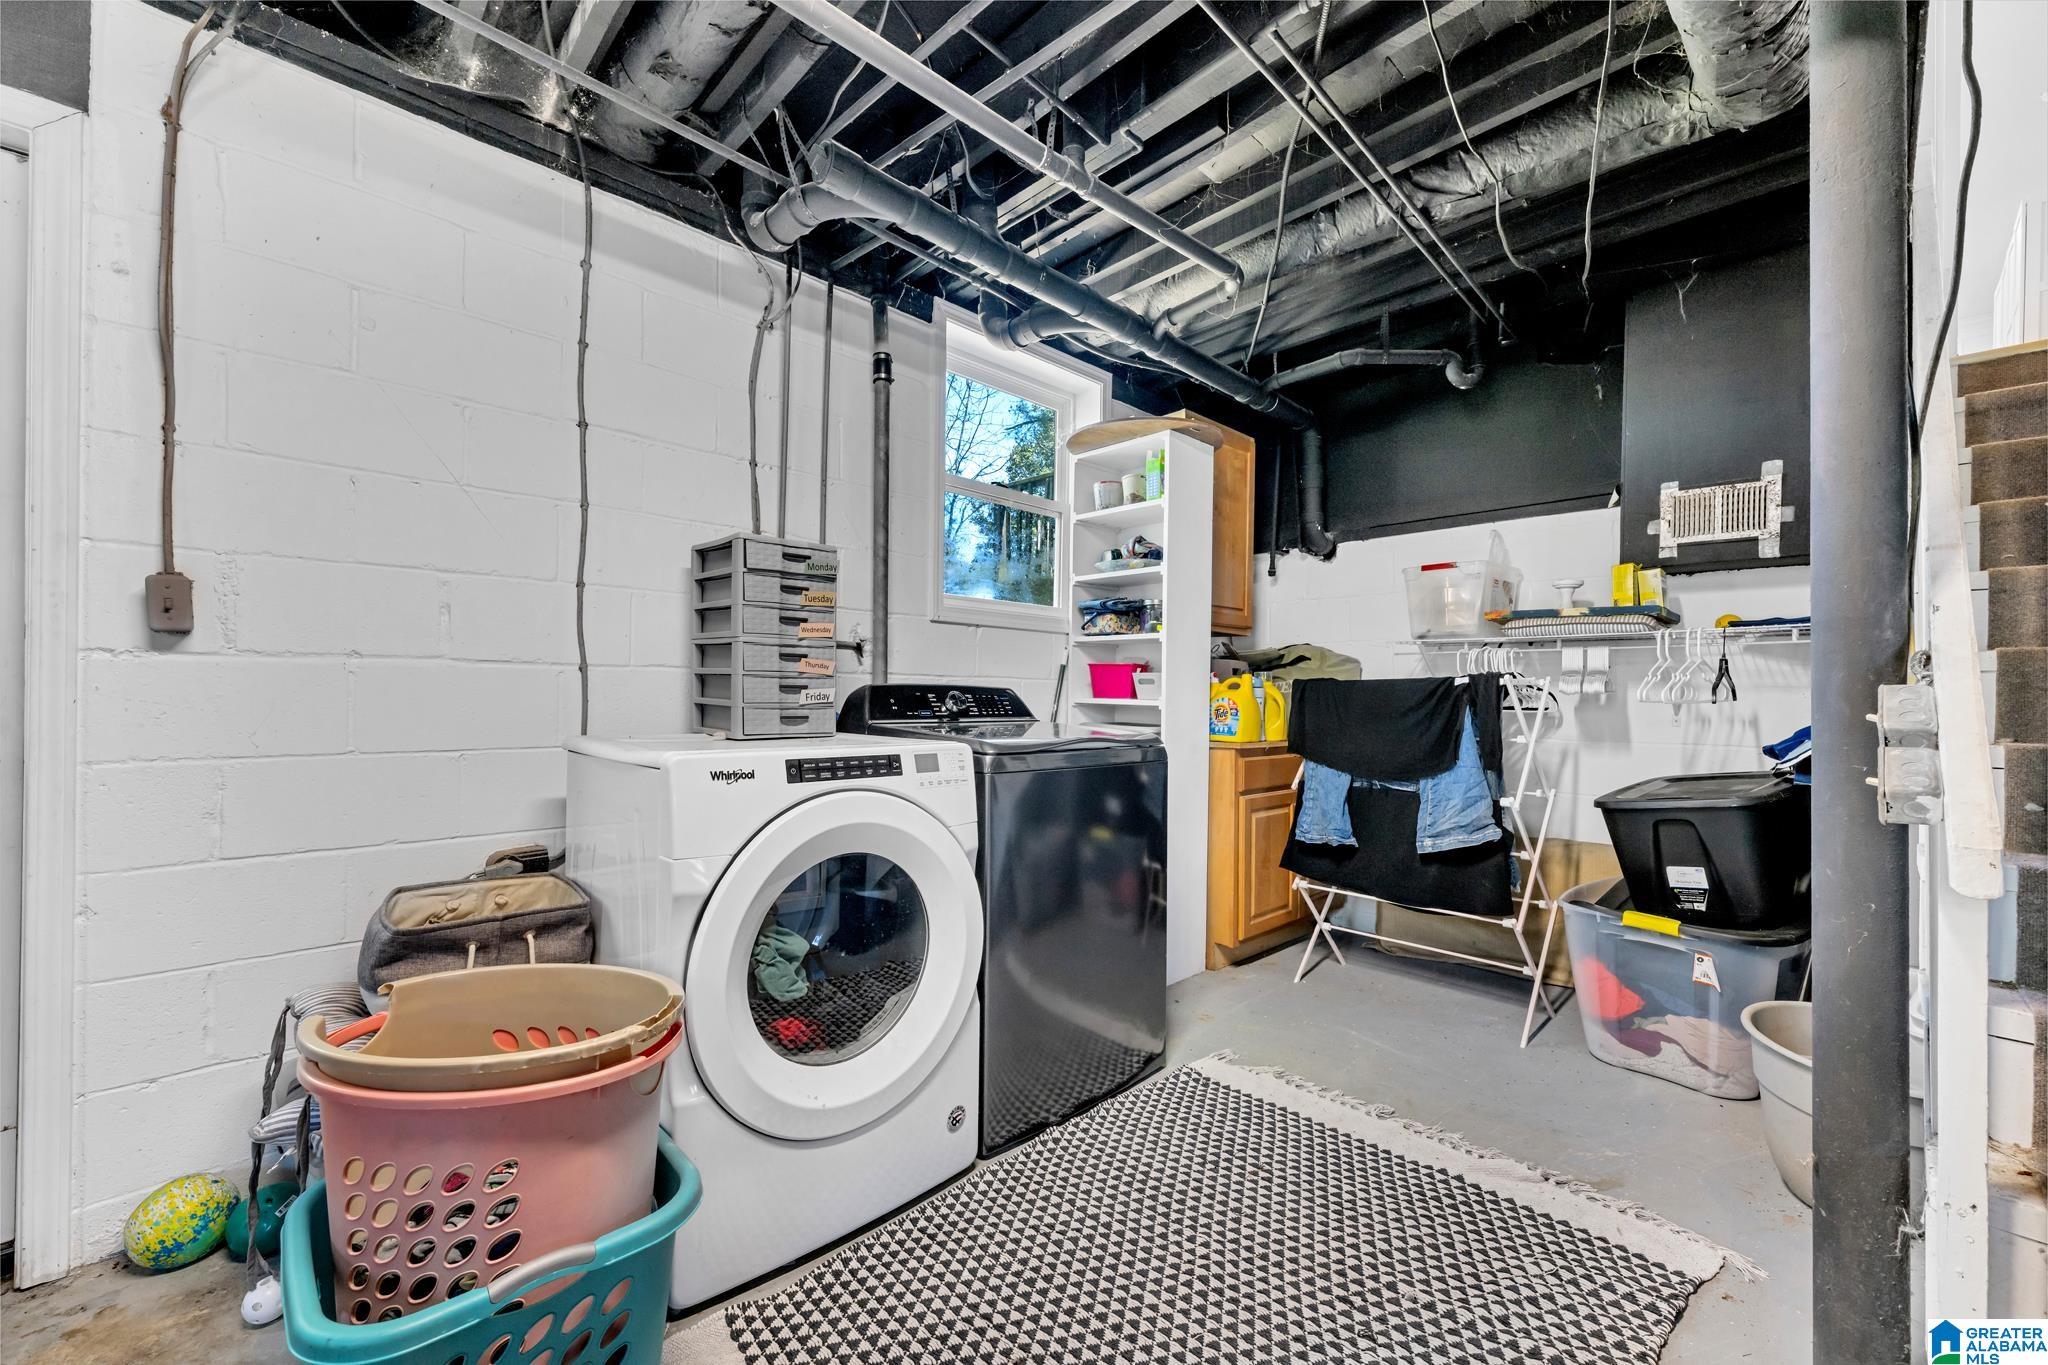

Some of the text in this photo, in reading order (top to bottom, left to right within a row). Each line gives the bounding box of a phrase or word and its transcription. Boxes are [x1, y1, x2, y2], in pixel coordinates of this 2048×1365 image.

[807, 562, 837, 573] Monday
[803, 593, 834, 604] Tuesday
[800, 626, 832, 635] Wednesday
[804, 660, 830, 670] Thursday
[805, 692, 831, 702] Friday
[1214, 708, 1229, 720] Tide
[709, 768, 756, 785] Whirlpool
